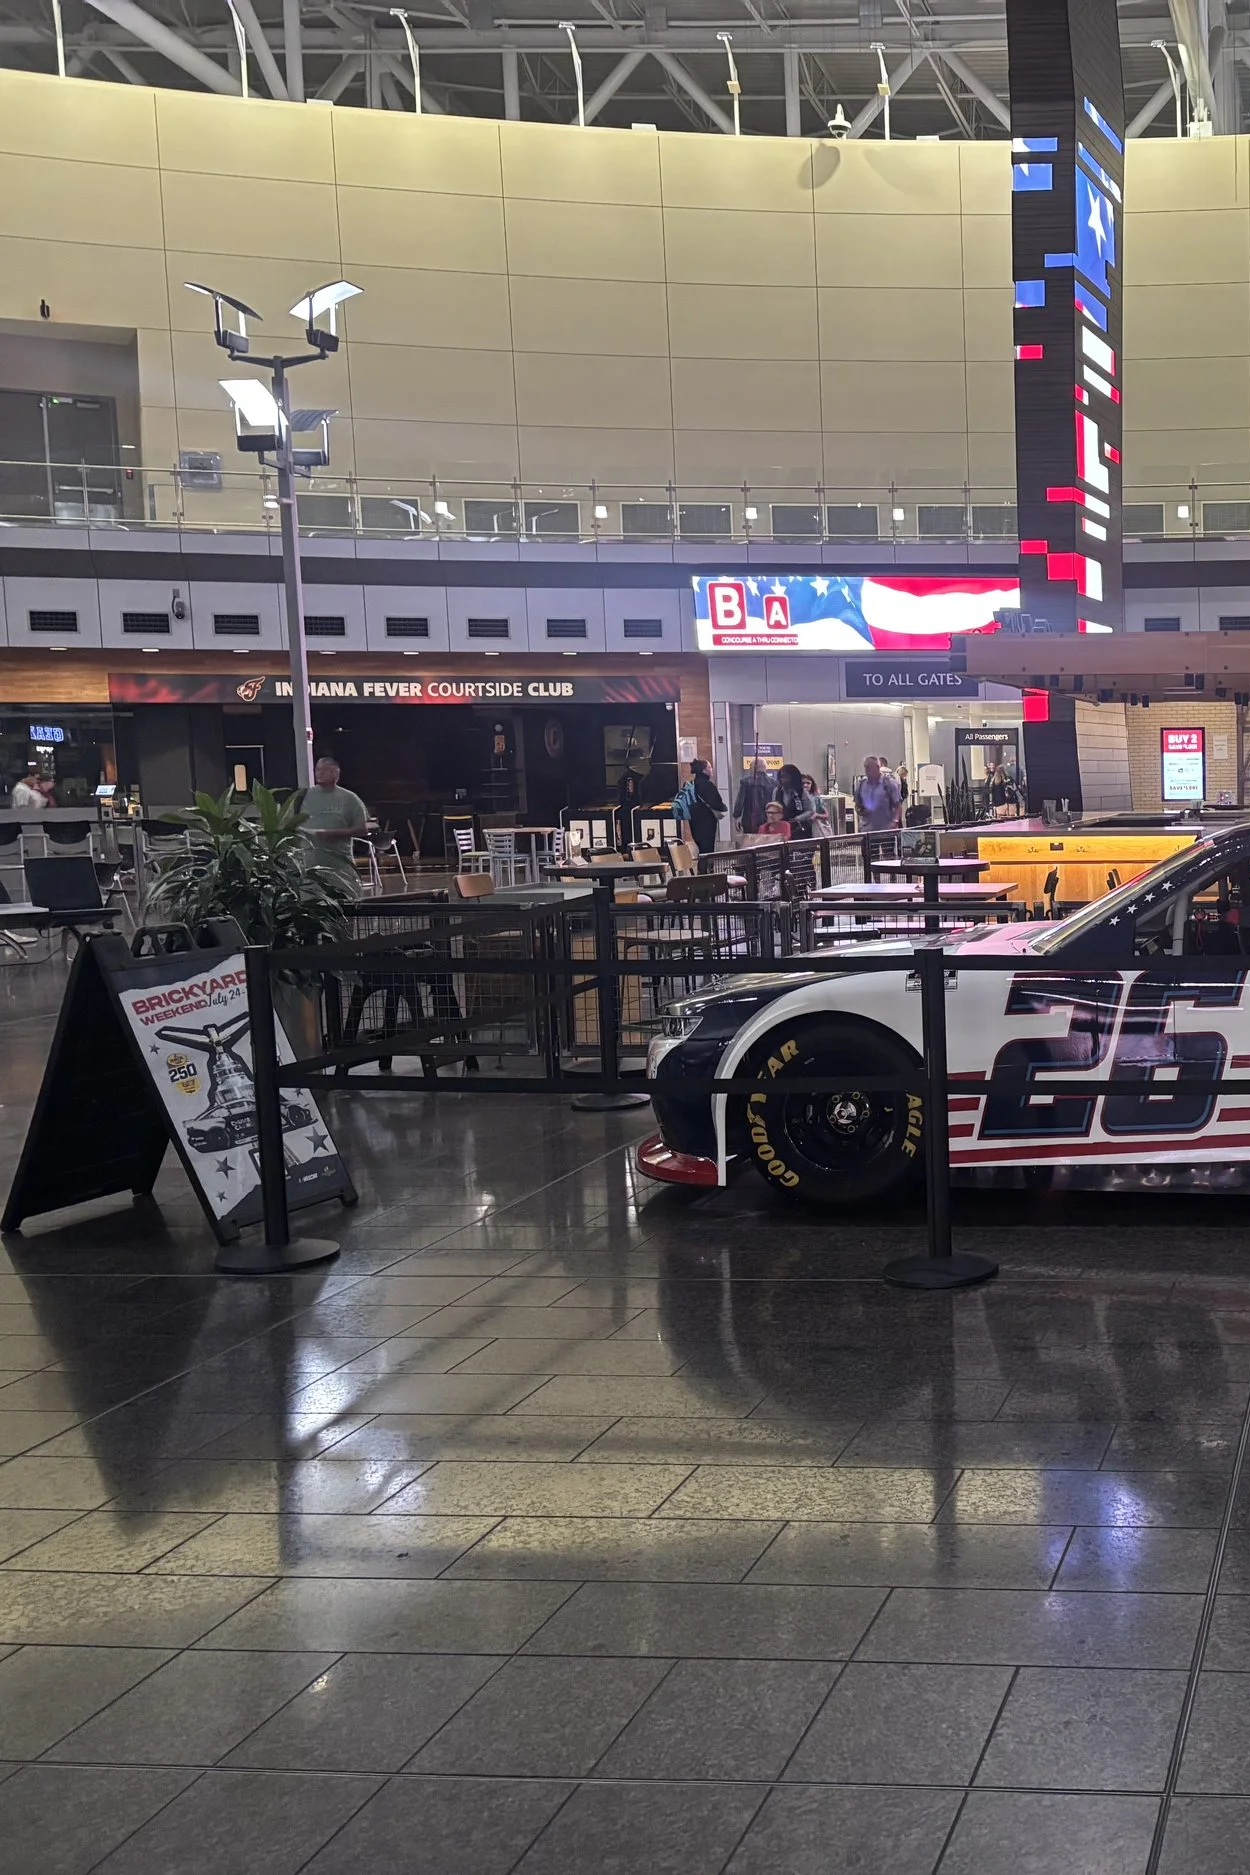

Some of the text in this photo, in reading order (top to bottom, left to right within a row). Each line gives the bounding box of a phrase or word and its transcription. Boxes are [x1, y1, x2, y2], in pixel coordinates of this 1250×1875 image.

[713, 586, 788, 626] B A
[275, 681, 574, 697] INIANA FEVER COURTSIDE CLUB
[863, 673, 962, 686] TO ALL GATES
[974, 733, 1009, 741] Passengers
[1168, 733, 1198, 744] BUY 2
[140, 999, 208, 1026] WEEKEND
[206, 992, 228, 1007] July
[977, 969, 1248, 1141] 26
[168, 1063, 197, 1083] 250
[900, 1091, 923, 1158] AGLE
